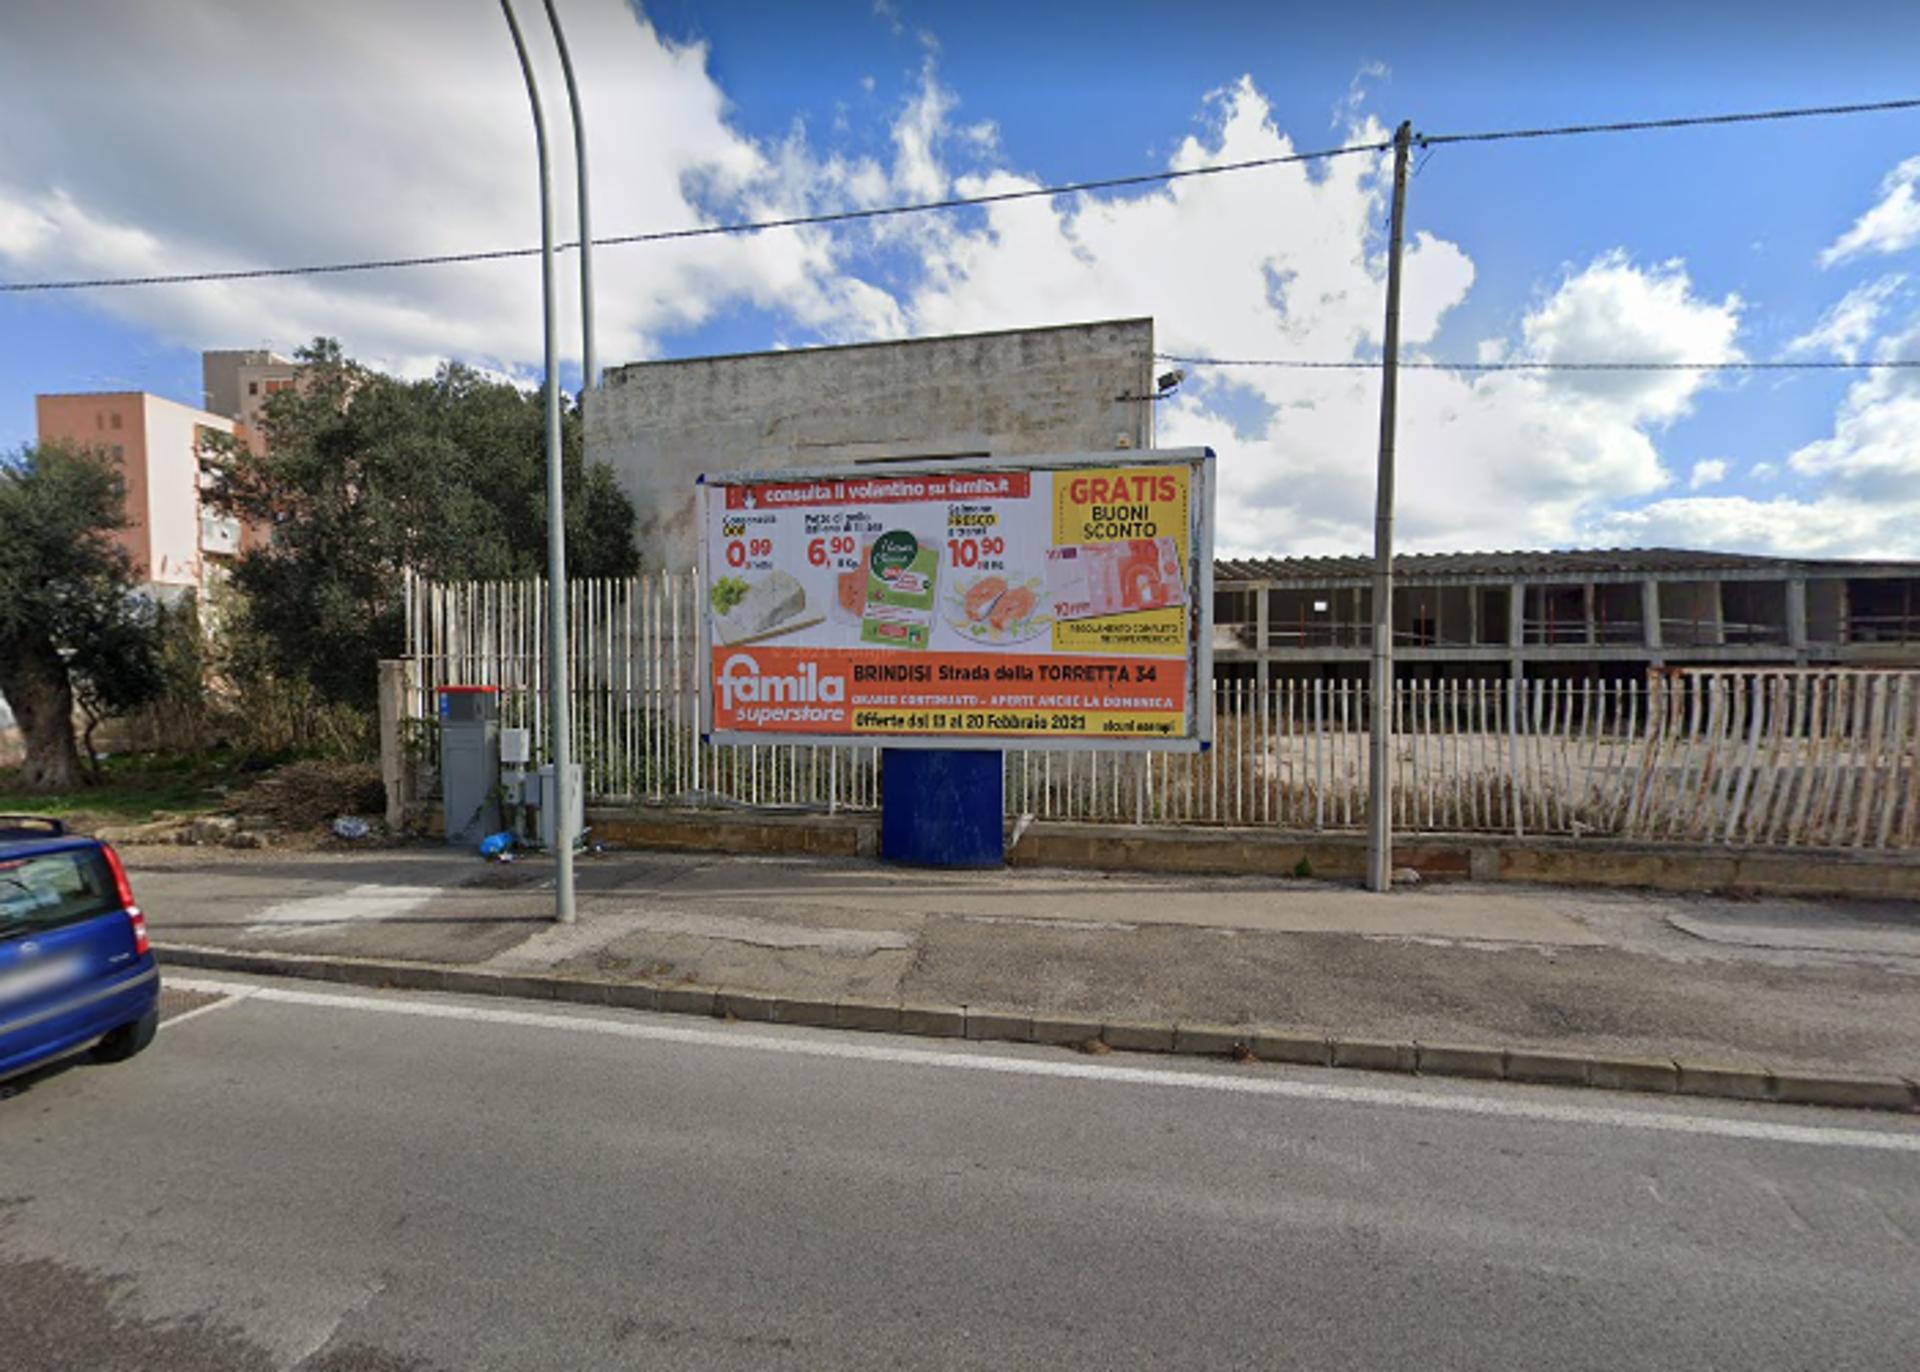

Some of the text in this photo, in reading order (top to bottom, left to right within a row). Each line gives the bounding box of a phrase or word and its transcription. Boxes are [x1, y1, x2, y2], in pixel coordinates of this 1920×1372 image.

[766, 484, 831, 503] consulta
[848, 478, 924, 499] volantino
[928, 483, 946, 496] su
[1070, 475, 1176, 504] GRATIS
[1091, 505, 1149, 522] BUONI
[1083, 522, 1157, 540] SCONTO
[717, 653, 845, 710] famila
[853, 664, 1157, 683] BRINDISI Strada della TORRETTA 34
[1083, 695, 1100, 708] LA
[1103, 695, 1174, 709] DOMENICA
[736, 704, 845, 727] superstore
[855, 711, 905, 728] Offerte
[949, 712, 963, 729] al
[966, 713, 984, 729] 20
[987, 713, 1048, 730] Febbraio
